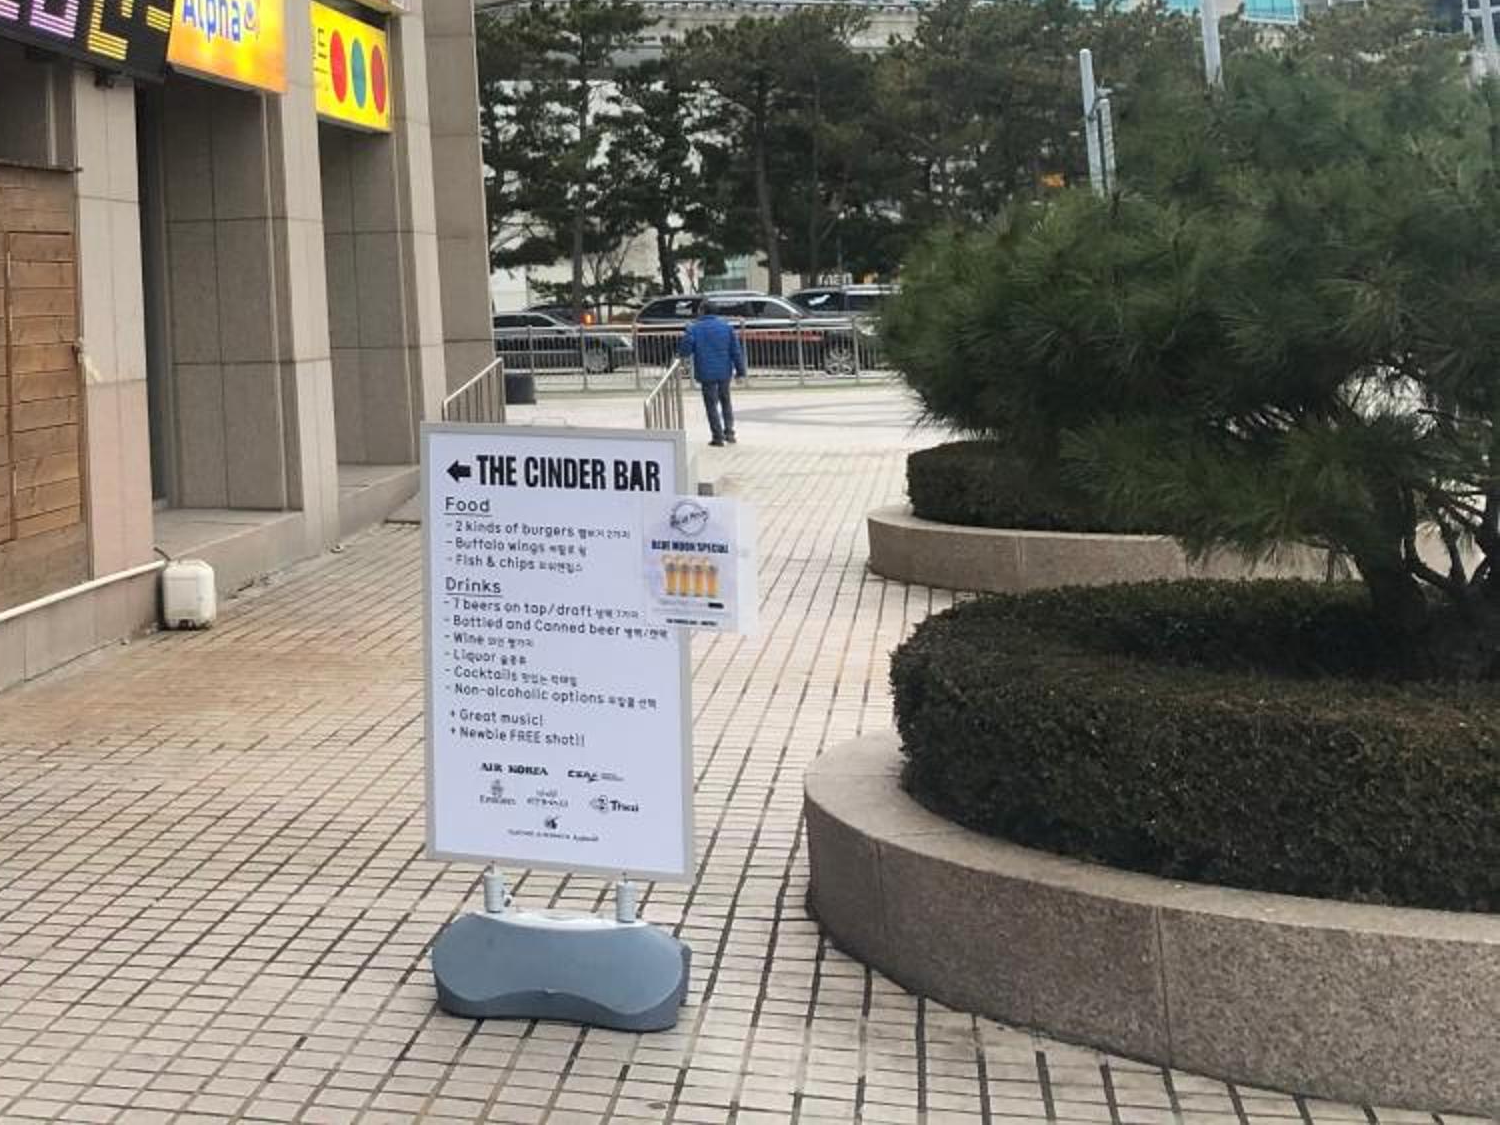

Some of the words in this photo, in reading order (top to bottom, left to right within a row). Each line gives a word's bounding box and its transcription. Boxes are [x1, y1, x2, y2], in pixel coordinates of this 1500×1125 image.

[476, 454, 517, 486] THE
[524, 456, 606, 490] CINDER
[613, 459, 661, 492] BAR
[445, 496, 490, 513] Food
[465, 520, 501, 534] kinds
[504, 522, 518, 534] of
[522, 523, 575, 538] burgers
[455, 536, 504, 550] Buffalo
[508, 540, 545, 555] wings
[456, 553, 482, 566] Fish
[486, 556, 495, 568] &
[499, 557, 535, 572] chips
[445, 576, 502, 593] Drinks
[463, 599, 501, 611] beers
[504, 602, 521, 613] on
[524, 602, 592, 617] tap/draft
[453, 615, 502, 629] Bottled
[506, 619, 531, 631] and
[534, 619, 585, 633] Canned
[589, 623, 621, 636] beer
[453, 632, 485, 645] Wine
[453, 648, 496, 664] Liquor
[454, 665, 517, 681] Cocktails
[455, 682, 548, 700] Non-alcoholic
[551, 690, 604, 704] options
[460, 708, 496, 723] Great
[500, 714, 543, 727] music!
[460, 726, 506, 741] Newbie
[509, 729, 541, 744] FREE
